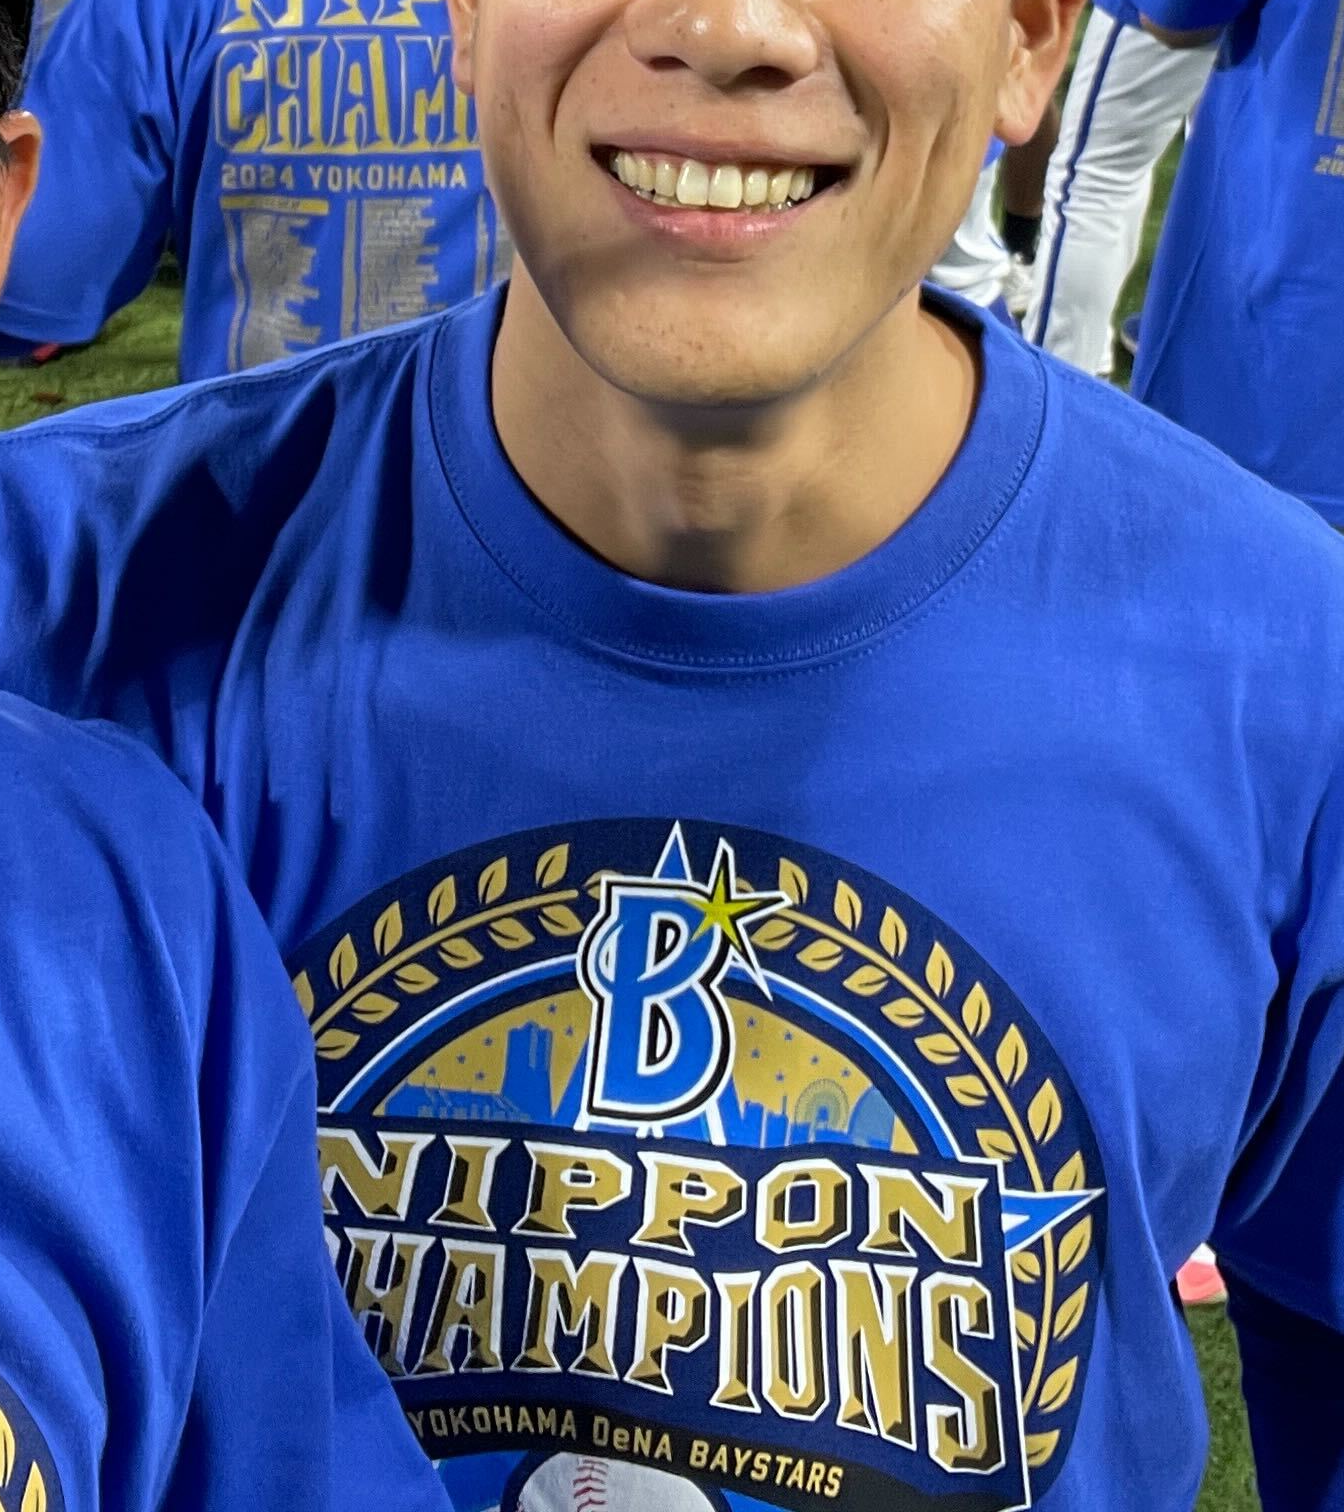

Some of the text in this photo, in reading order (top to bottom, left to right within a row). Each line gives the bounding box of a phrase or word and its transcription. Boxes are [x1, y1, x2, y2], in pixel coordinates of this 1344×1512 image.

[220, 164, 467, 193] 2024 YOKOHAMA
[318, 1129, 990, 1270] NIPPON
[409, 1408, 844, 1499] YOKOHAMA DeNA BAYSTARS
